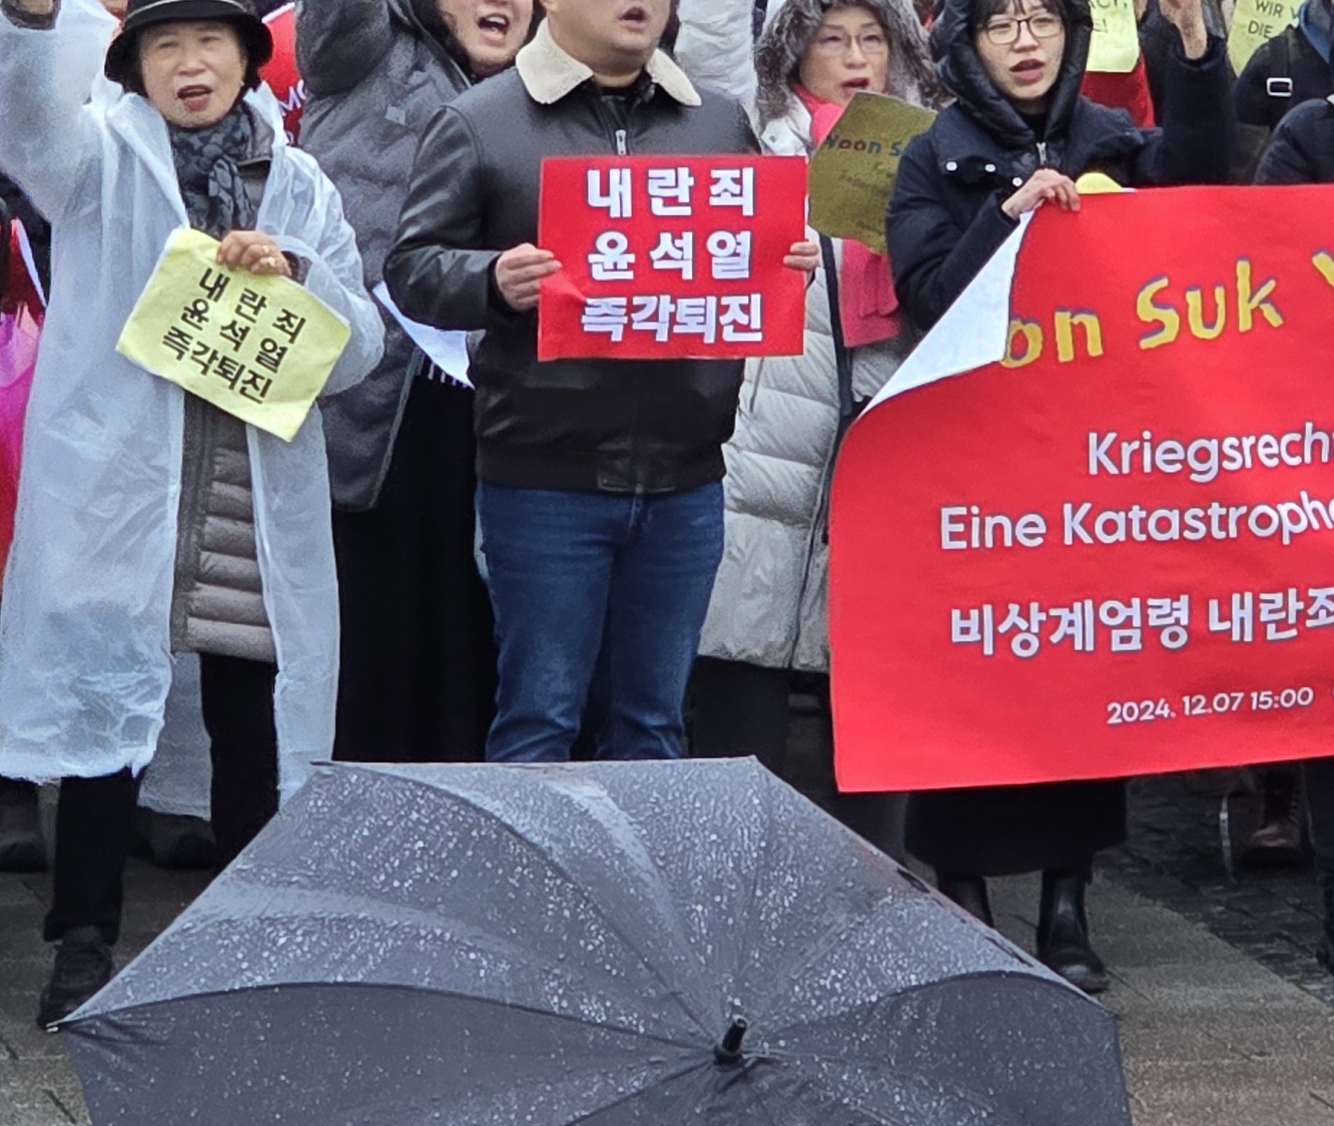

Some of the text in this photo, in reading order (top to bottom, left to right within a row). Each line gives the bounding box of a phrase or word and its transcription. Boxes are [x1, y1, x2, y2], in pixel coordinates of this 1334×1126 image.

[587, 166, 755, 218] 내란죄
[587, 230, 752, 281] 윤석열
[199, 267, 307, 344] 내란죄
[581, 293, 763, 344] 즉각퇴진
[999, 308, 1104, 368] on
[1136, 257, 1284, 350] Suk
[180, 298, 288, 374] 윤석열
[162, 325, 273, 405] 즉각퇴진
[940, 505, 1048, 551] Eine
[950, 595, 1190, 658] 비상계엄령
[1106, 700, 1176, 725] 2024.
[1182, 691, 1245, 717] 12.07
[1249, 686, 1315, 711] 15:00
